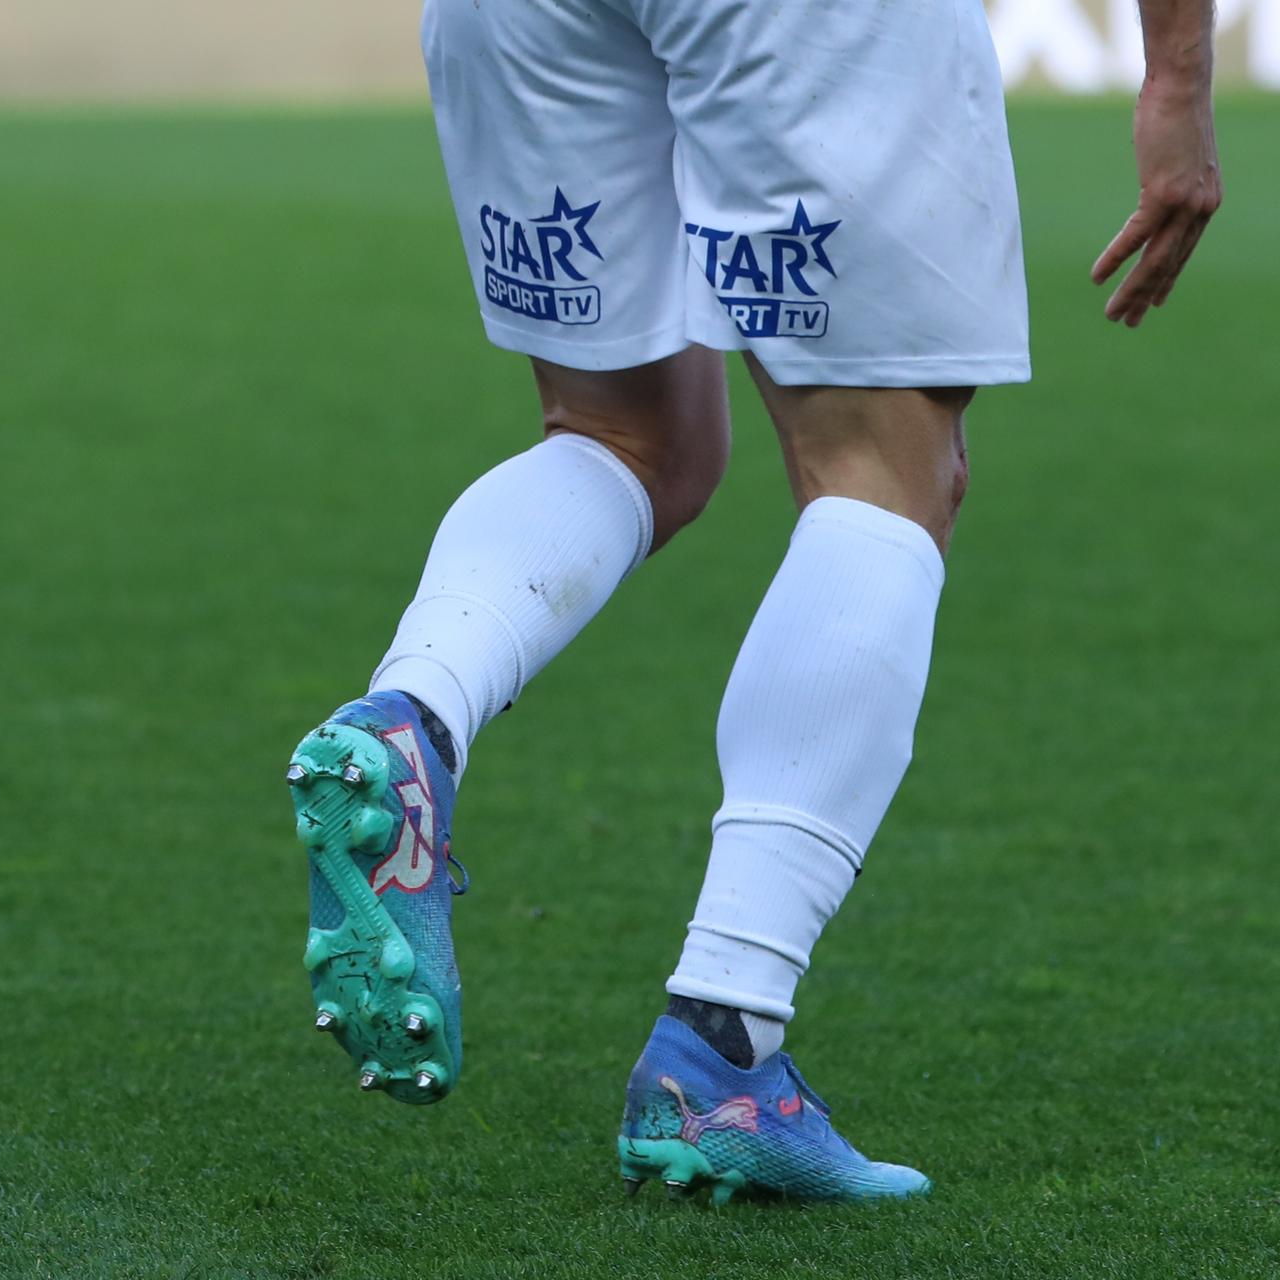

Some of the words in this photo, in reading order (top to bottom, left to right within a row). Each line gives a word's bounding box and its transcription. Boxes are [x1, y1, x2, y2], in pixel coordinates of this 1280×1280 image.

[480, 204, 588, 281] STAR
[685, 223, 819, 296] TAR
[487, 273, 549, 314] SPORT
[559, 295, 592, 316] TV
[785, 310, 820, 329] TV
